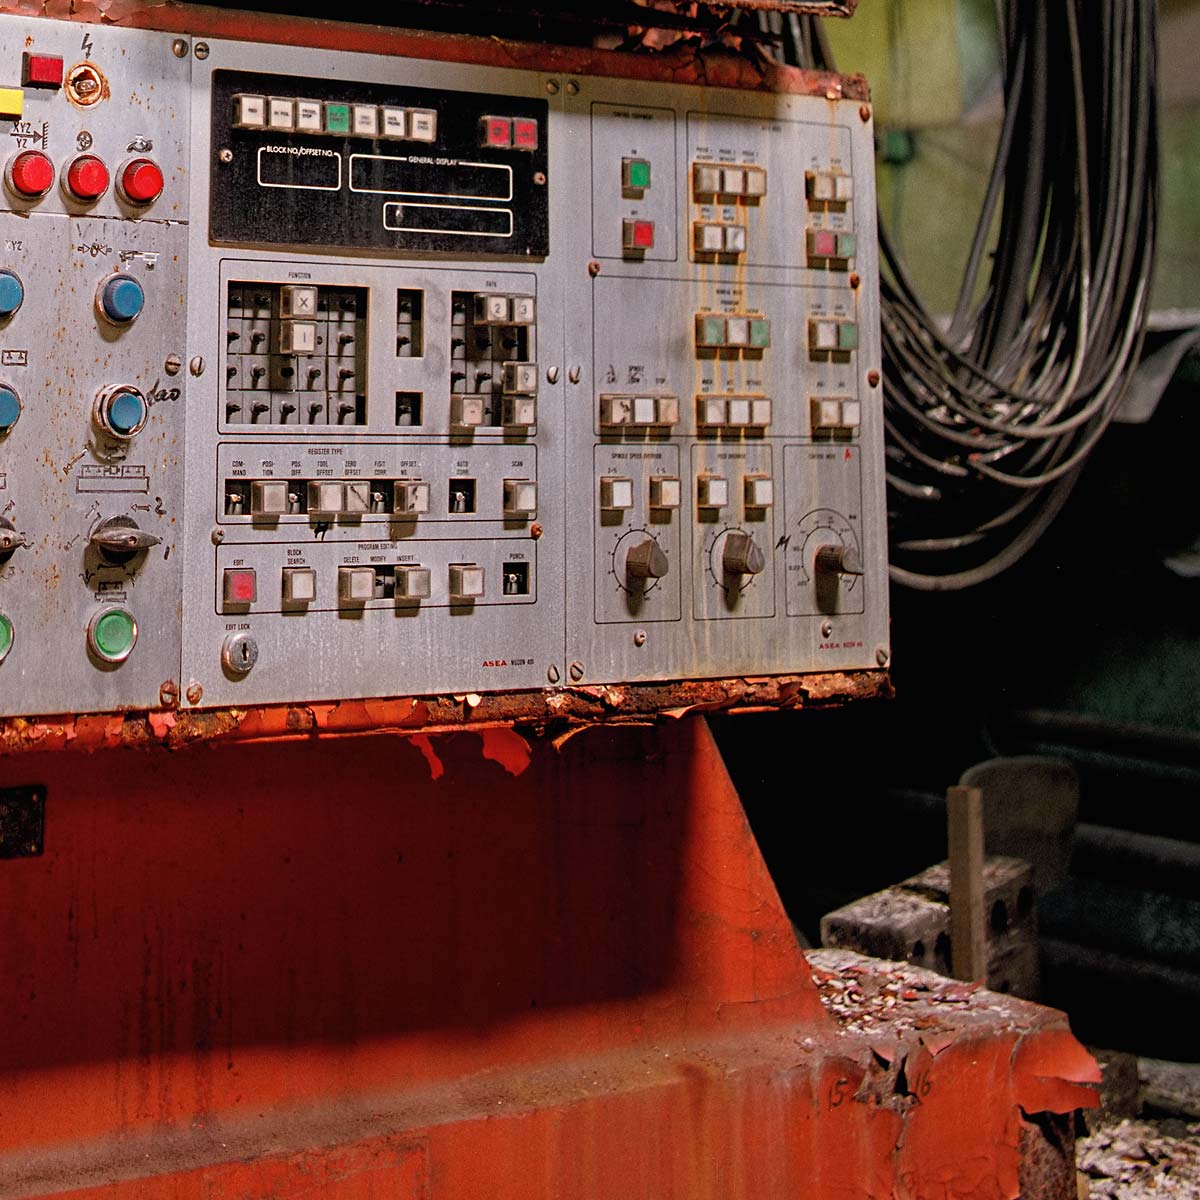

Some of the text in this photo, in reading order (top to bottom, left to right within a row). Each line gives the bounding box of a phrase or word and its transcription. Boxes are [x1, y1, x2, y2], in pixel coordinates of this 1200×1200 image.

[13, 121, 31, 133] XYZ
[266, 146, 287, 154] BLOCK
[408, 156, 458, 166] GENERAL DISPLAY
[288, 271, 312, 279] FUNCTION
[300, 297, 309, 308] X
[225, 623, 236, 631] EDIT
[482, 659, 508, 668] ASEA
